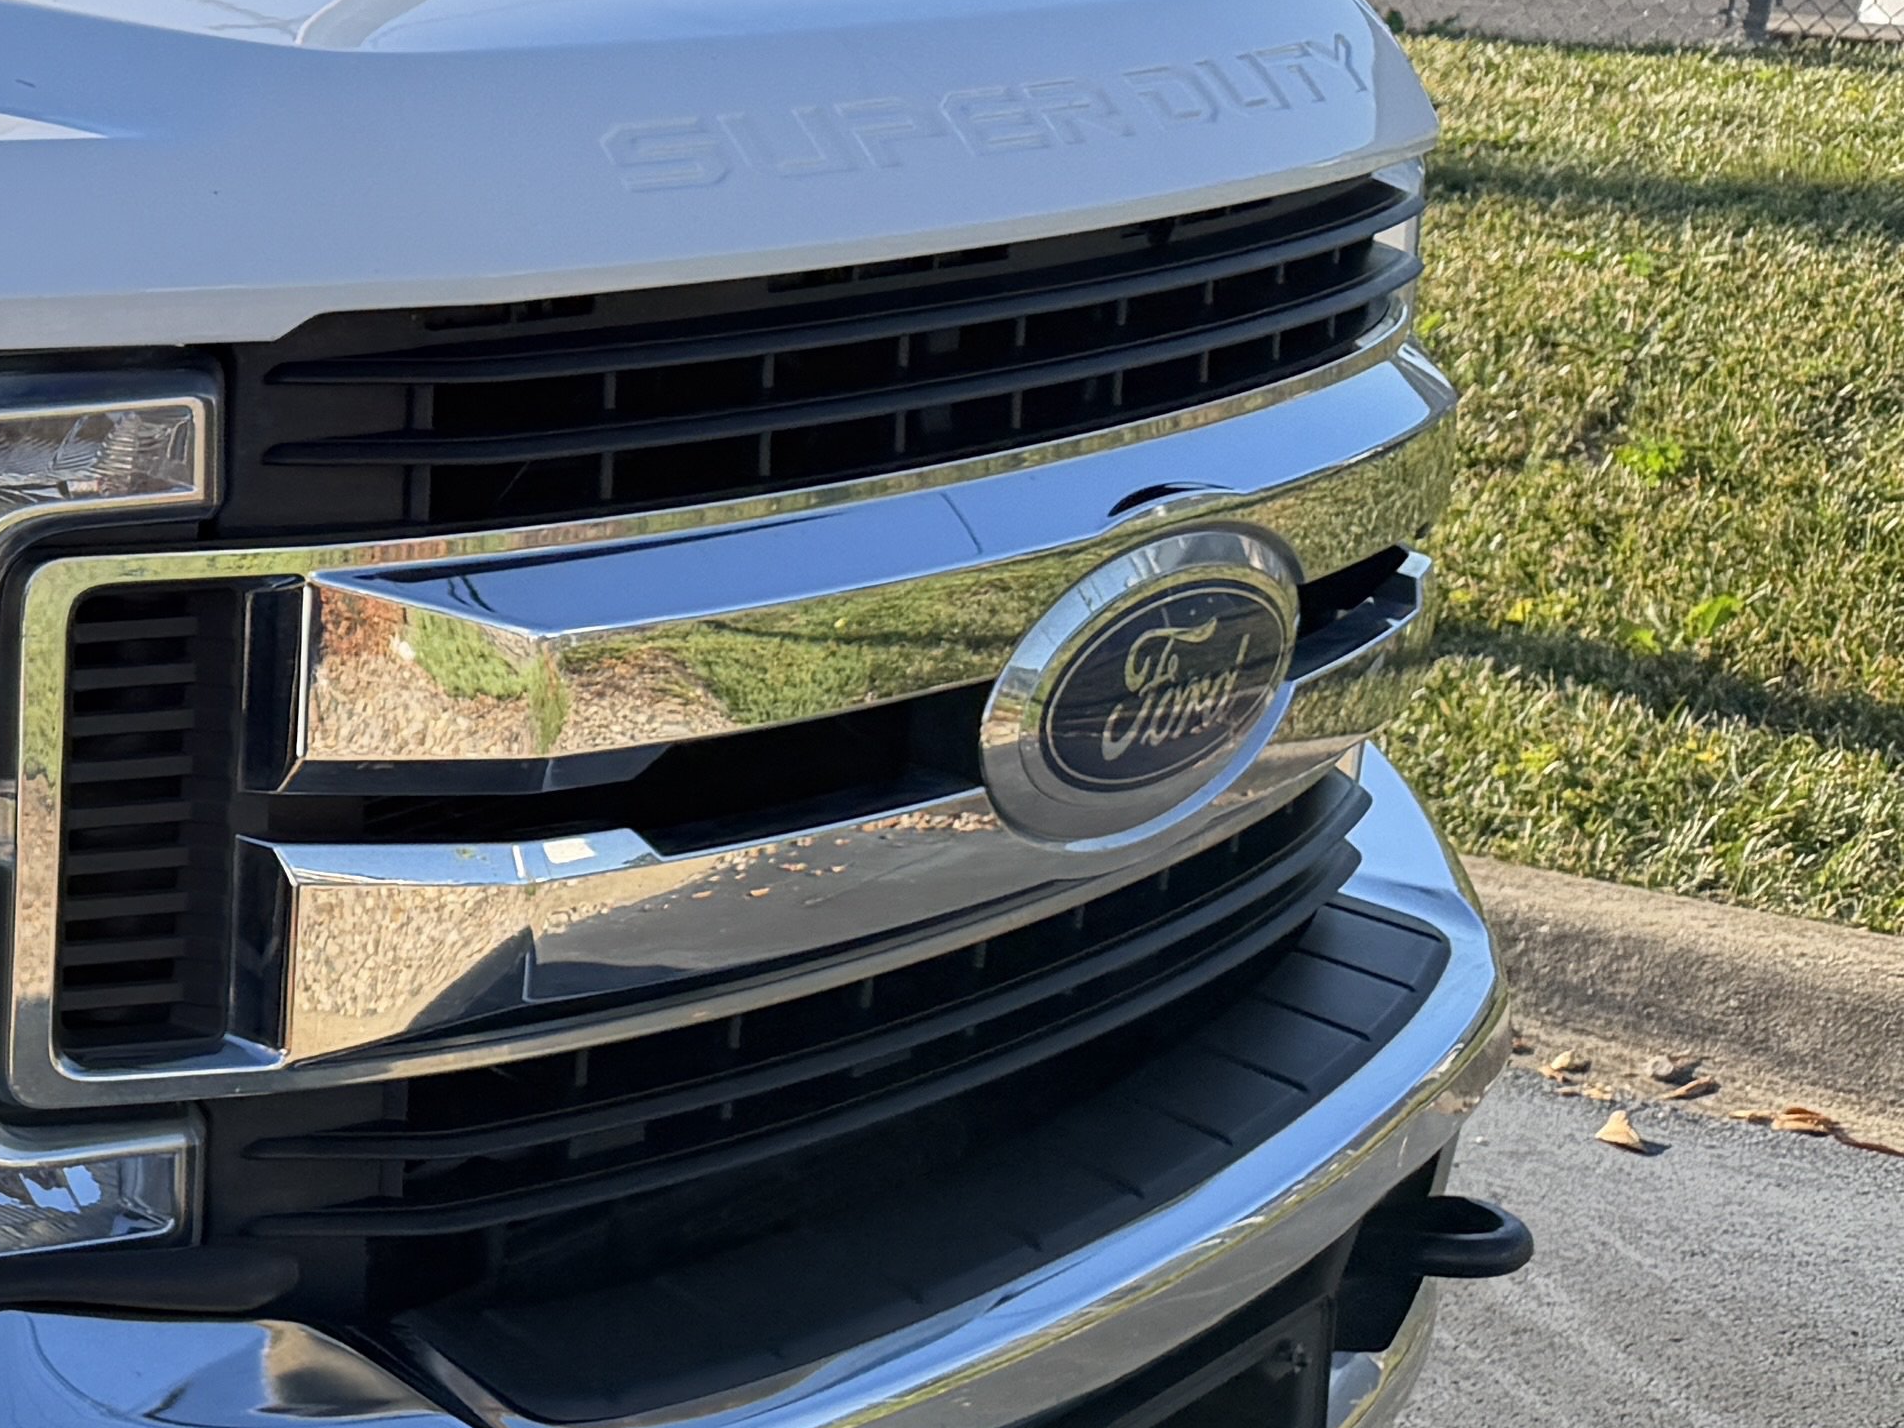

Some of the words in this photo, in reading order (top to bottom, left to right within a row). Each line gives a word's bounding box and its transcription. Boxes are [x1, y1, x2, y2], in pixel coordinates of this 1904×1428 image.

[599, 76, 1134, 194] SUPER
[1123, 30, 1369, 126] DUTY
[1100, 616, 1252, 762] Ford
